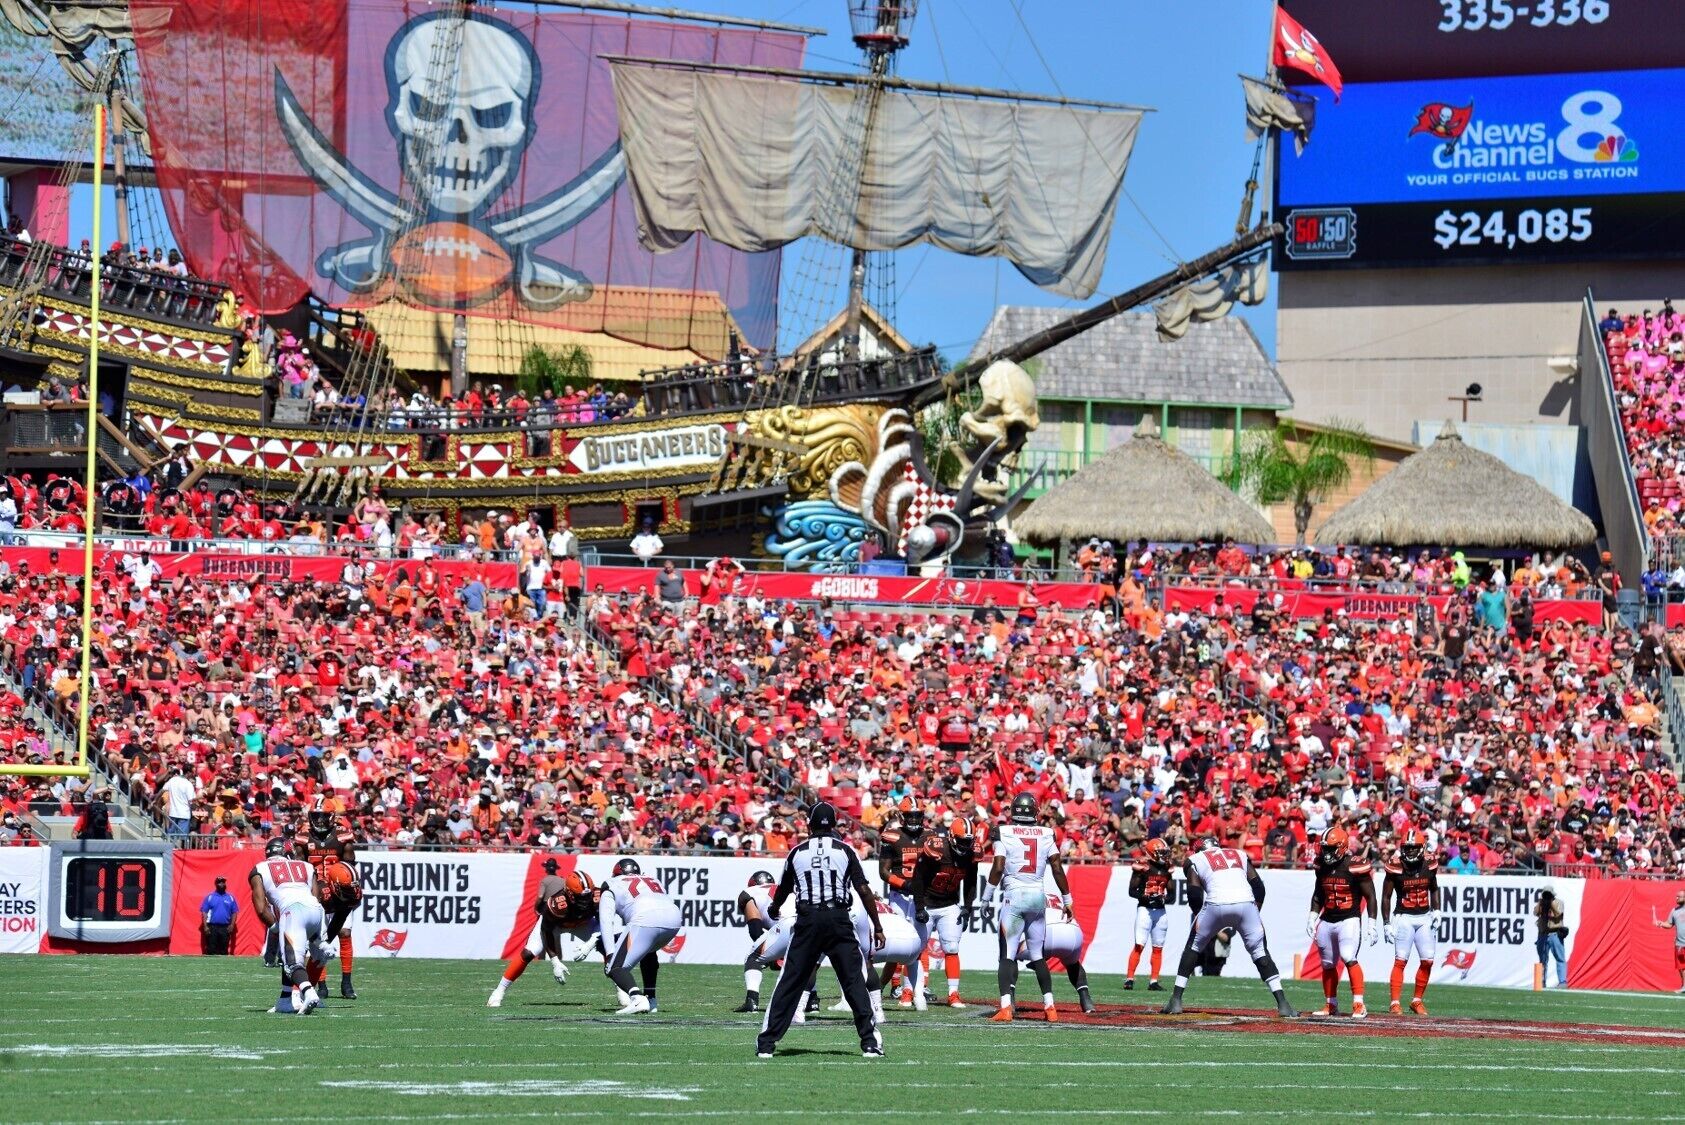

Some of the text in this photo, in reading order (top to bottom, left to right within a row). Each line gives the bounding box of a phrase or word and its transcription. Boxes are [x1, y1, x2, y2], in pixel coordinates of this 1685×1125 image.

[1438, 0, 1610, 32] 335-336
[1432, 90, 1627, 169] Channel 8
[1463, 120, 1546, 146] News
[1407, 166, 1639, 186] YOUR OFFICIAL BUCS STATION
[1434, 207, 1592, 249] $24,085
[203, 558, 293, 578] BUCCANEERS
[811, 576, 879, 599] #GOBUCS
[1012, 828, 1044, 836] WINSTON
[1018, 838, 1038, 874] 3
[1203, 850, 1245, 873] 69
[267, 860, 309, 888] 80
[97, 863, 147, 917] 10
[0, 917, 36, 932] ION
[674, 899, 748, 928] AKERS
